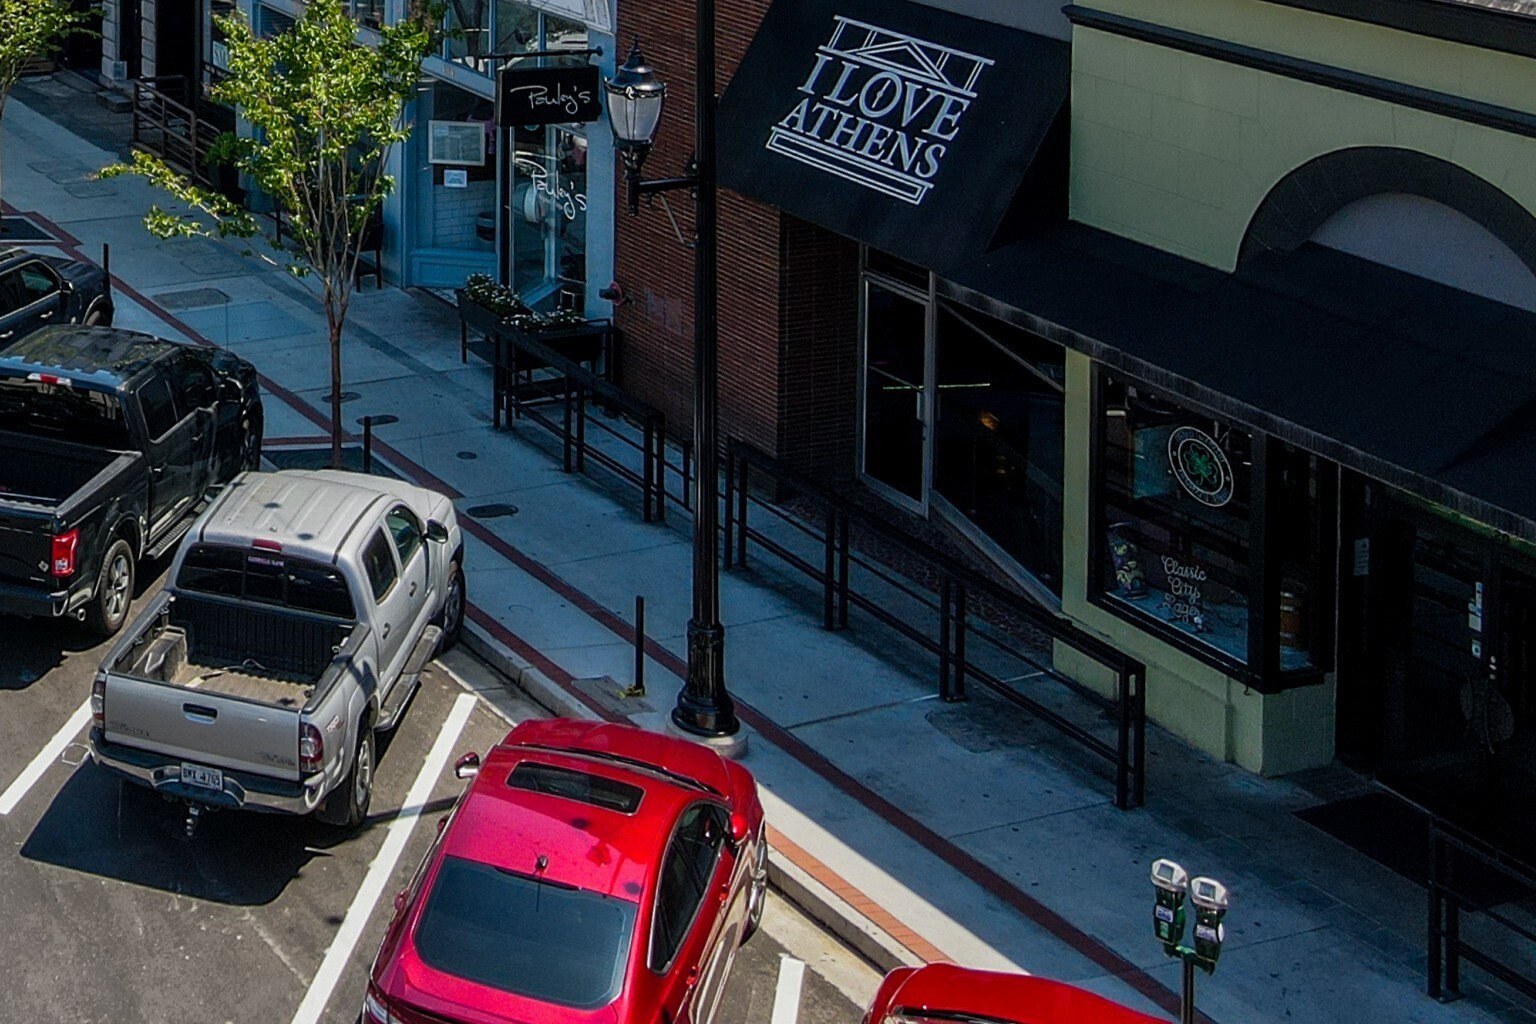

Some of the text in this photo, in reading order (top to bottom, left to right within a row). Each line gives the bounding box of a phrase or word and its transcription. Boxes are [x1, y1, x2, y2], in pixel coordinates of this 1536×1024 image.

[797, 52, 970, 142] I LOVE
[777, 97, 947, 180] ATHENS
[1161, 554, 1207, 581] Classic
[1167, 575, 1200, 604] City
